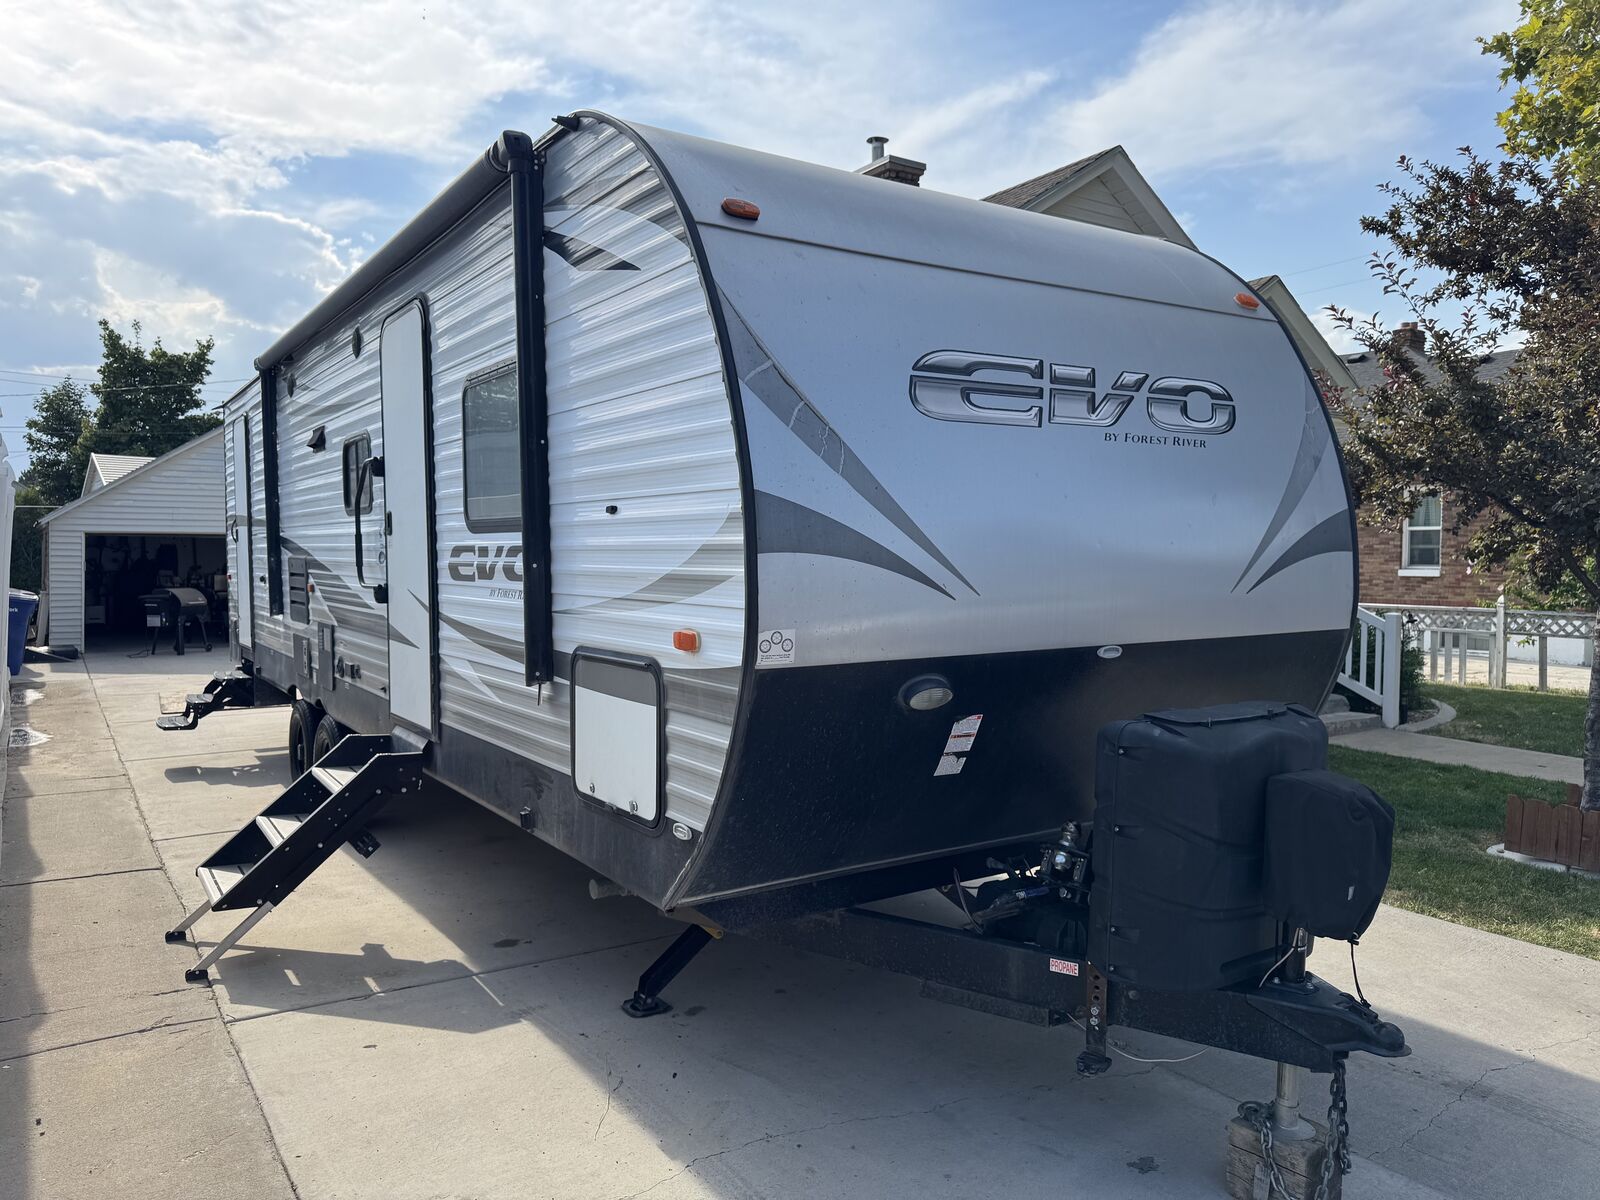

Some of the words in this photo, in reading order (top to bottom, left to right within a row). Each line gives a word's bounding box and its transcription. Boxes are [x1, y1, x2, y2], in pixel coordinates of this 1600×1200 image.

[908, 349, 1236, 435] EVO
[1104, 432, 1120, 442] BY
[1050, 960, 1078, 975] PROPANE
